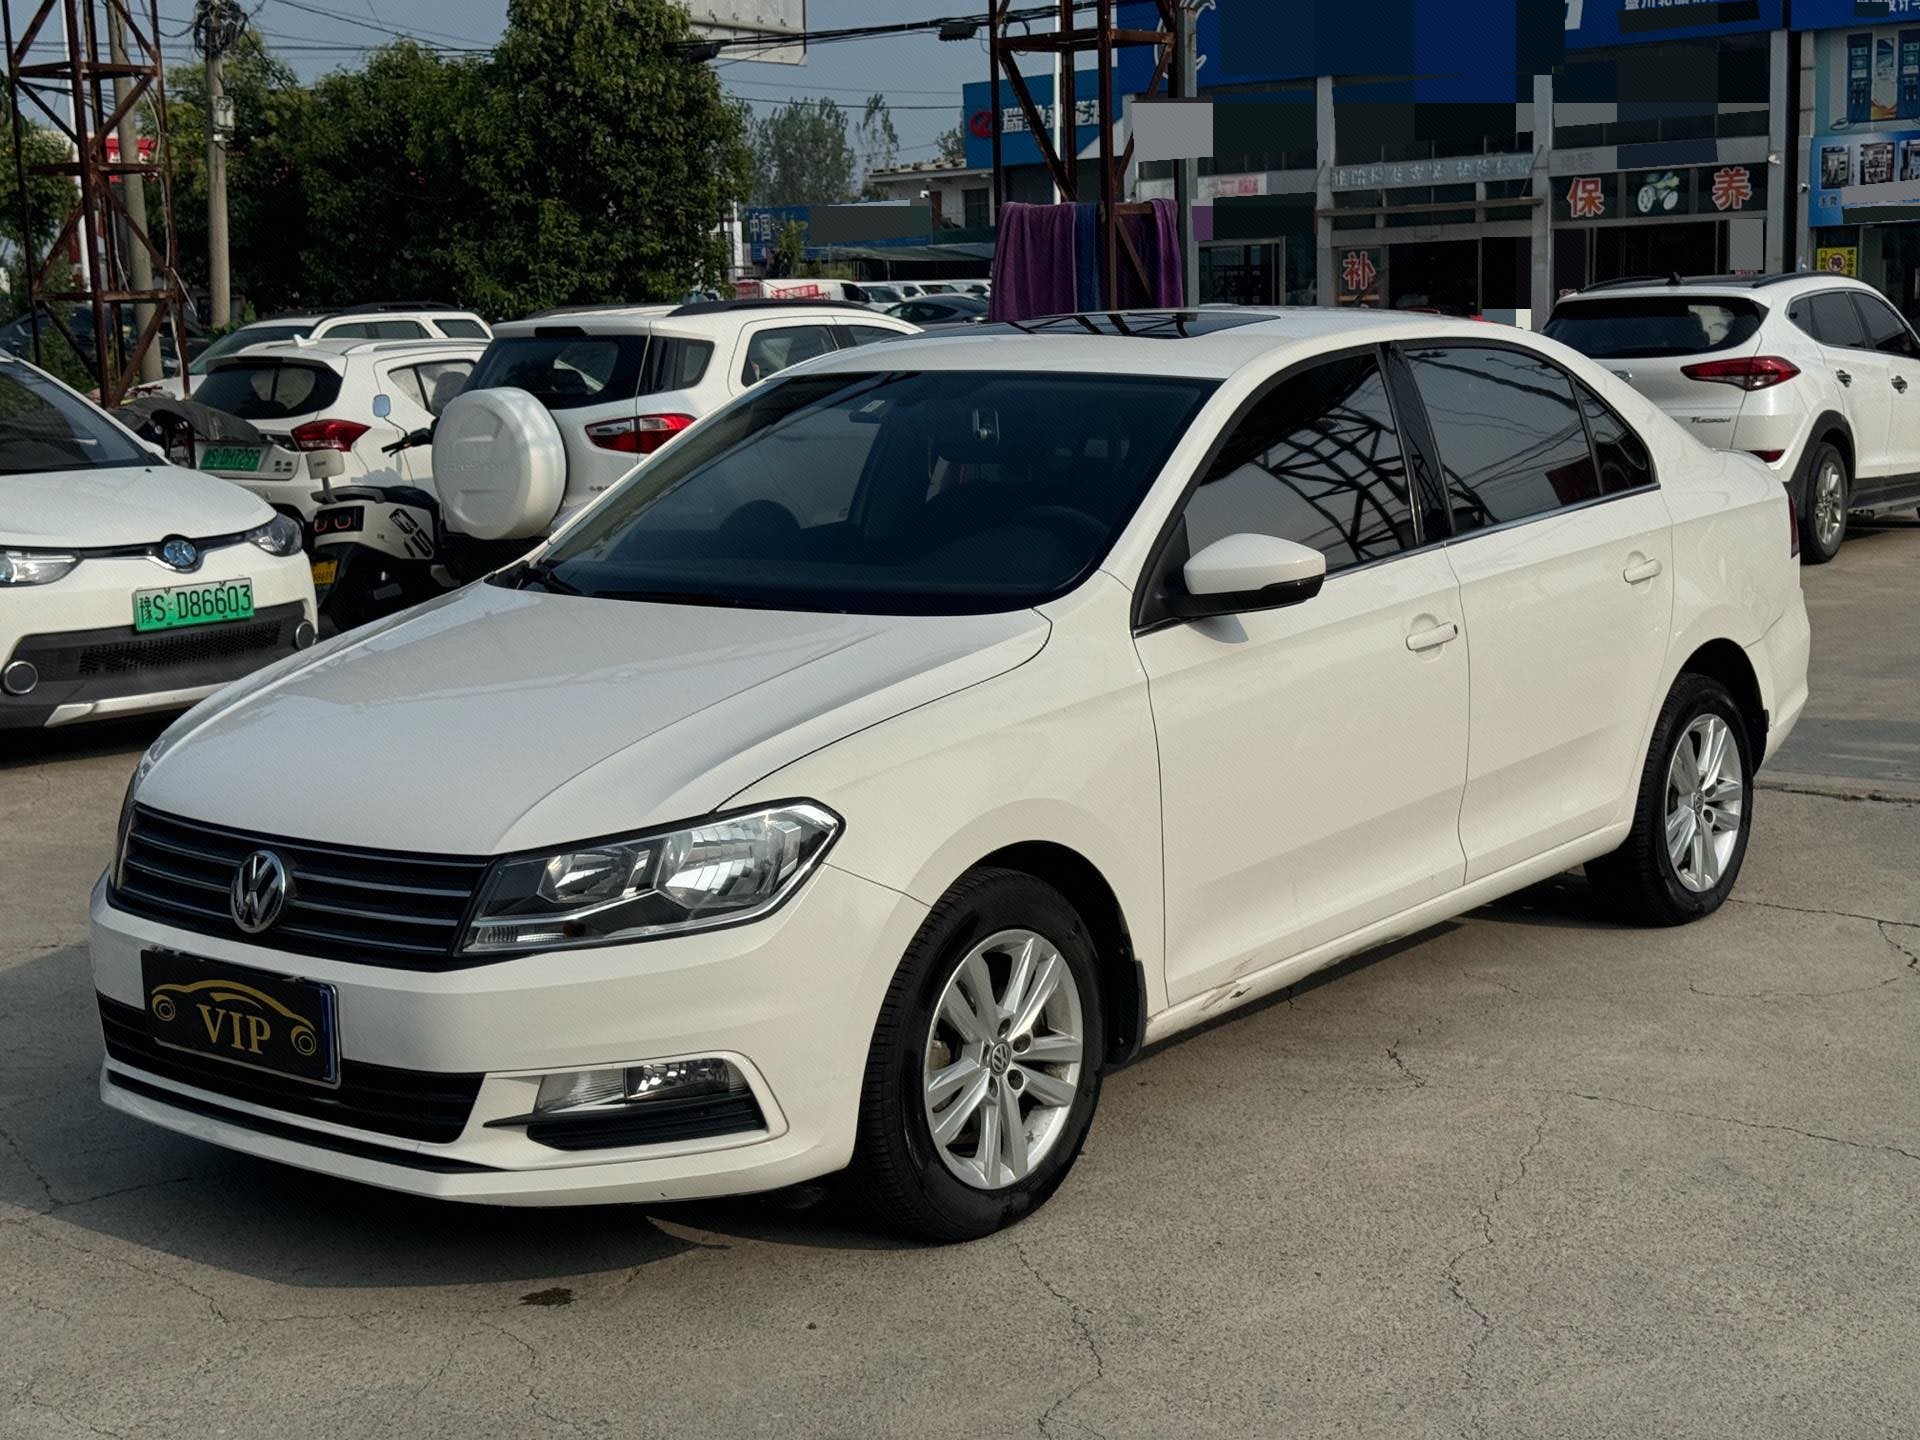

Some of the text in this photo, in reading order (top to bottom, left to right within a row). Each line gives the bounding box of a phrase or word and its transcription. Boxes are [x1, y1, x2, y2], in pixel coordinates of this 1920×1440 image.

[1566, 167, 1752, 218] 保 养
[1342, 250, 1377, 291] 补
[196, 1003, 271, 1055] VIP
